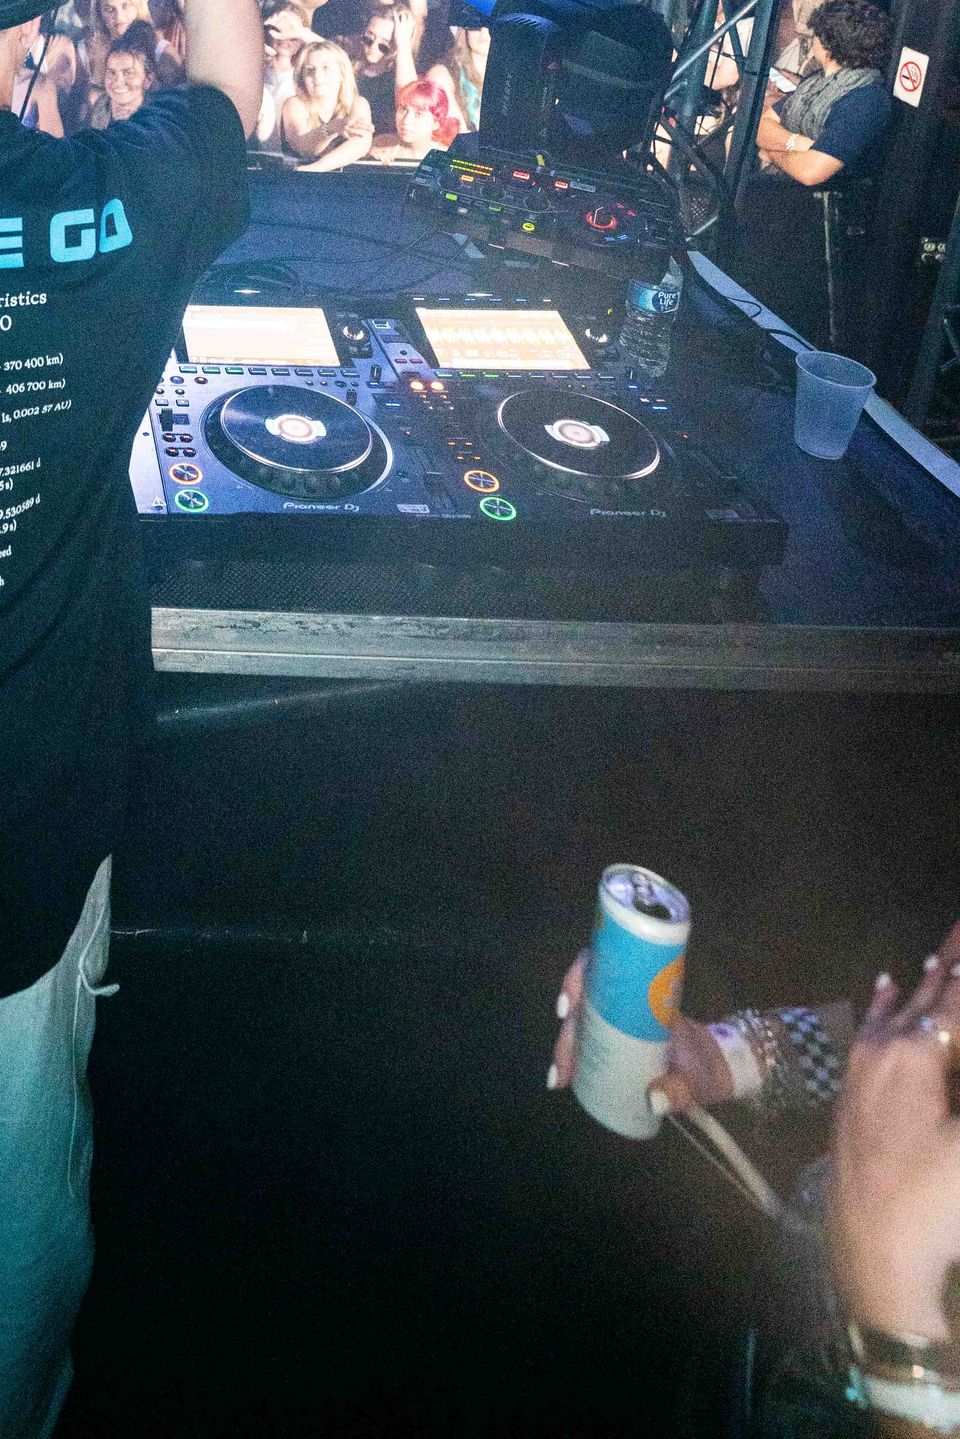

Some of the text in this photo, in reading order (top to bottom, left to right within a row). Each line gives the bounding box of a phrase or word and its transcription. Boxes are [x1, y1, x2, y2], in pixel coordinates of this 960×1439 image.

[49, 198, 133, 263] GO
[658, 291, 677, 299] Pure
[659, 298, 674, 307] Life
[3, 360, 23, 371] 370
[24, 357, 45, 369] 400
[45, 353, 64, 367] km)
[5, 382, 26, 395] 406
[26, 380, 46, 392] 700
[48, 378, 66, 391] km)
[13, 407, 40, 420] 0.002
[54, 399, 72, 412] AU)
[282, 502, 341, 511] Pioneer
[590, 508, 646, 517] Pioneer
